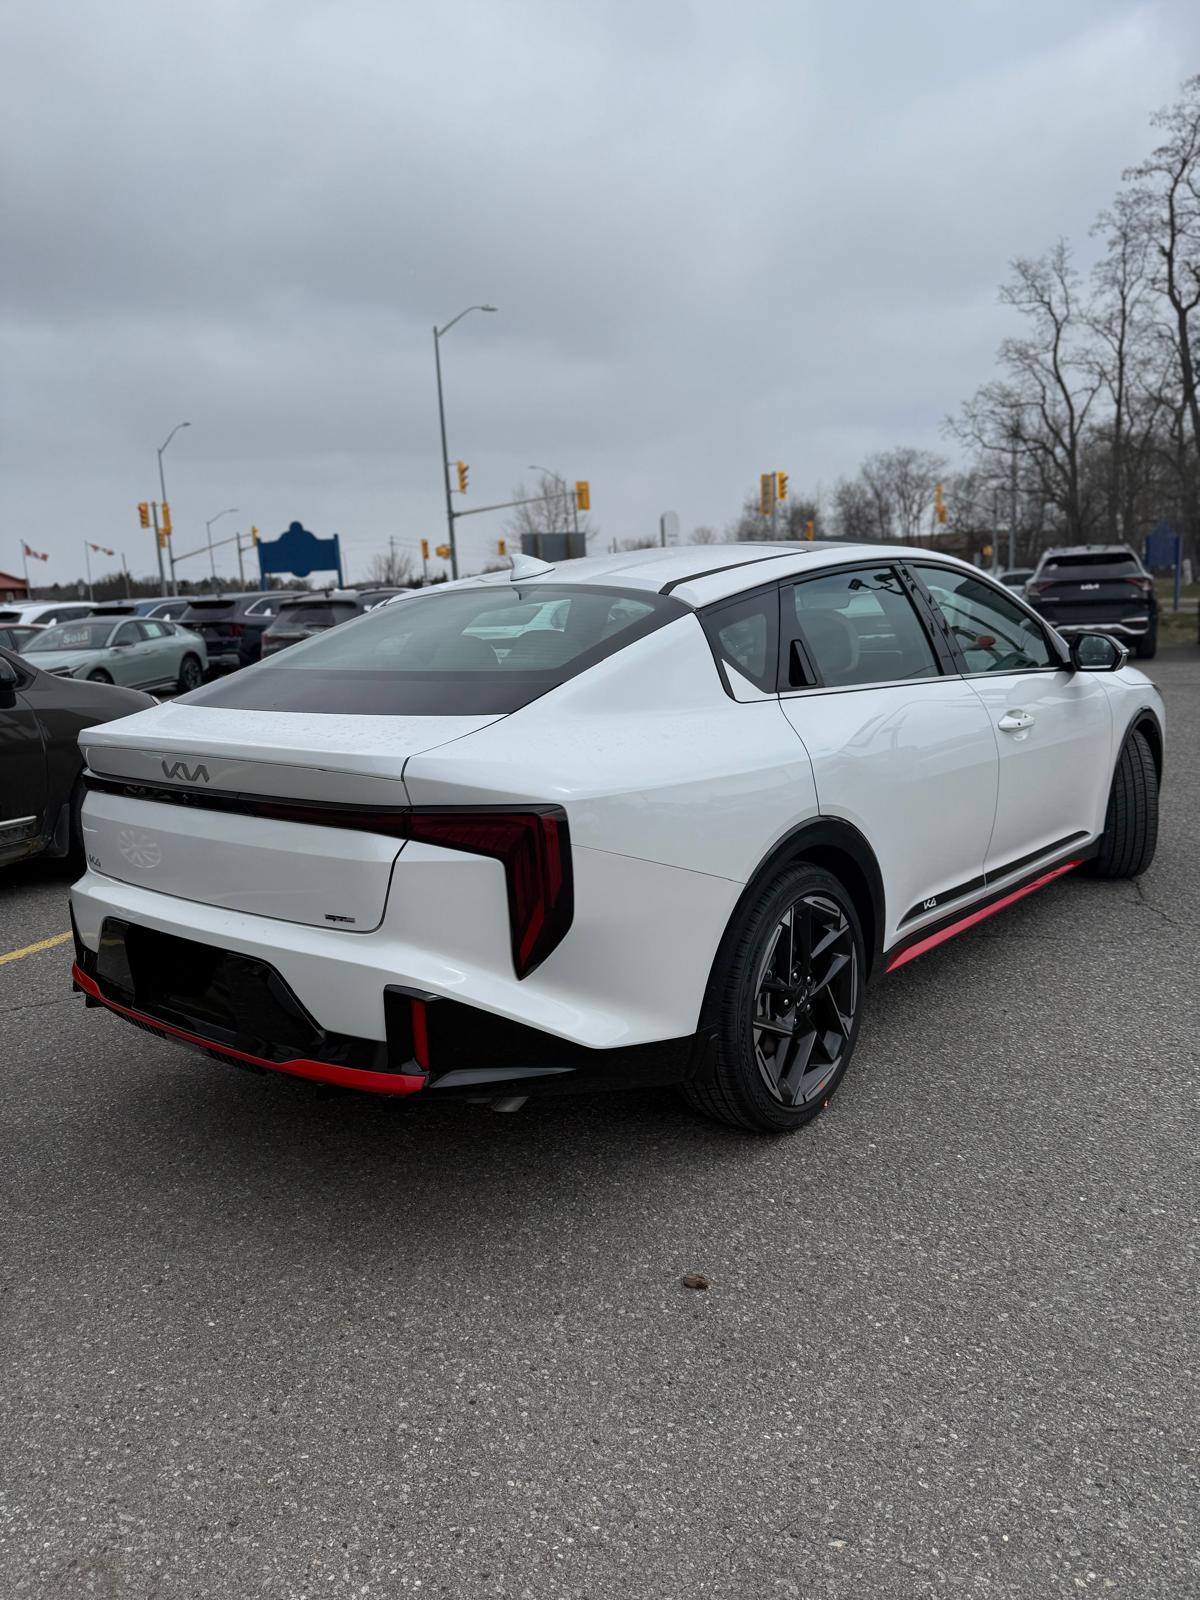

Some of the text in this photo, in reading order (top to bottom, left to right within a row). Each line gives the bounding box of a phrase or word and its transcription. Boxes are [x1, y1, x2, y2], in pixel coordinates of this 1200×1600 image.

[63, 631, 89, 643] Sold
[161, 760, 210, 783] KIA
[923, 897, 937, 910] K4
